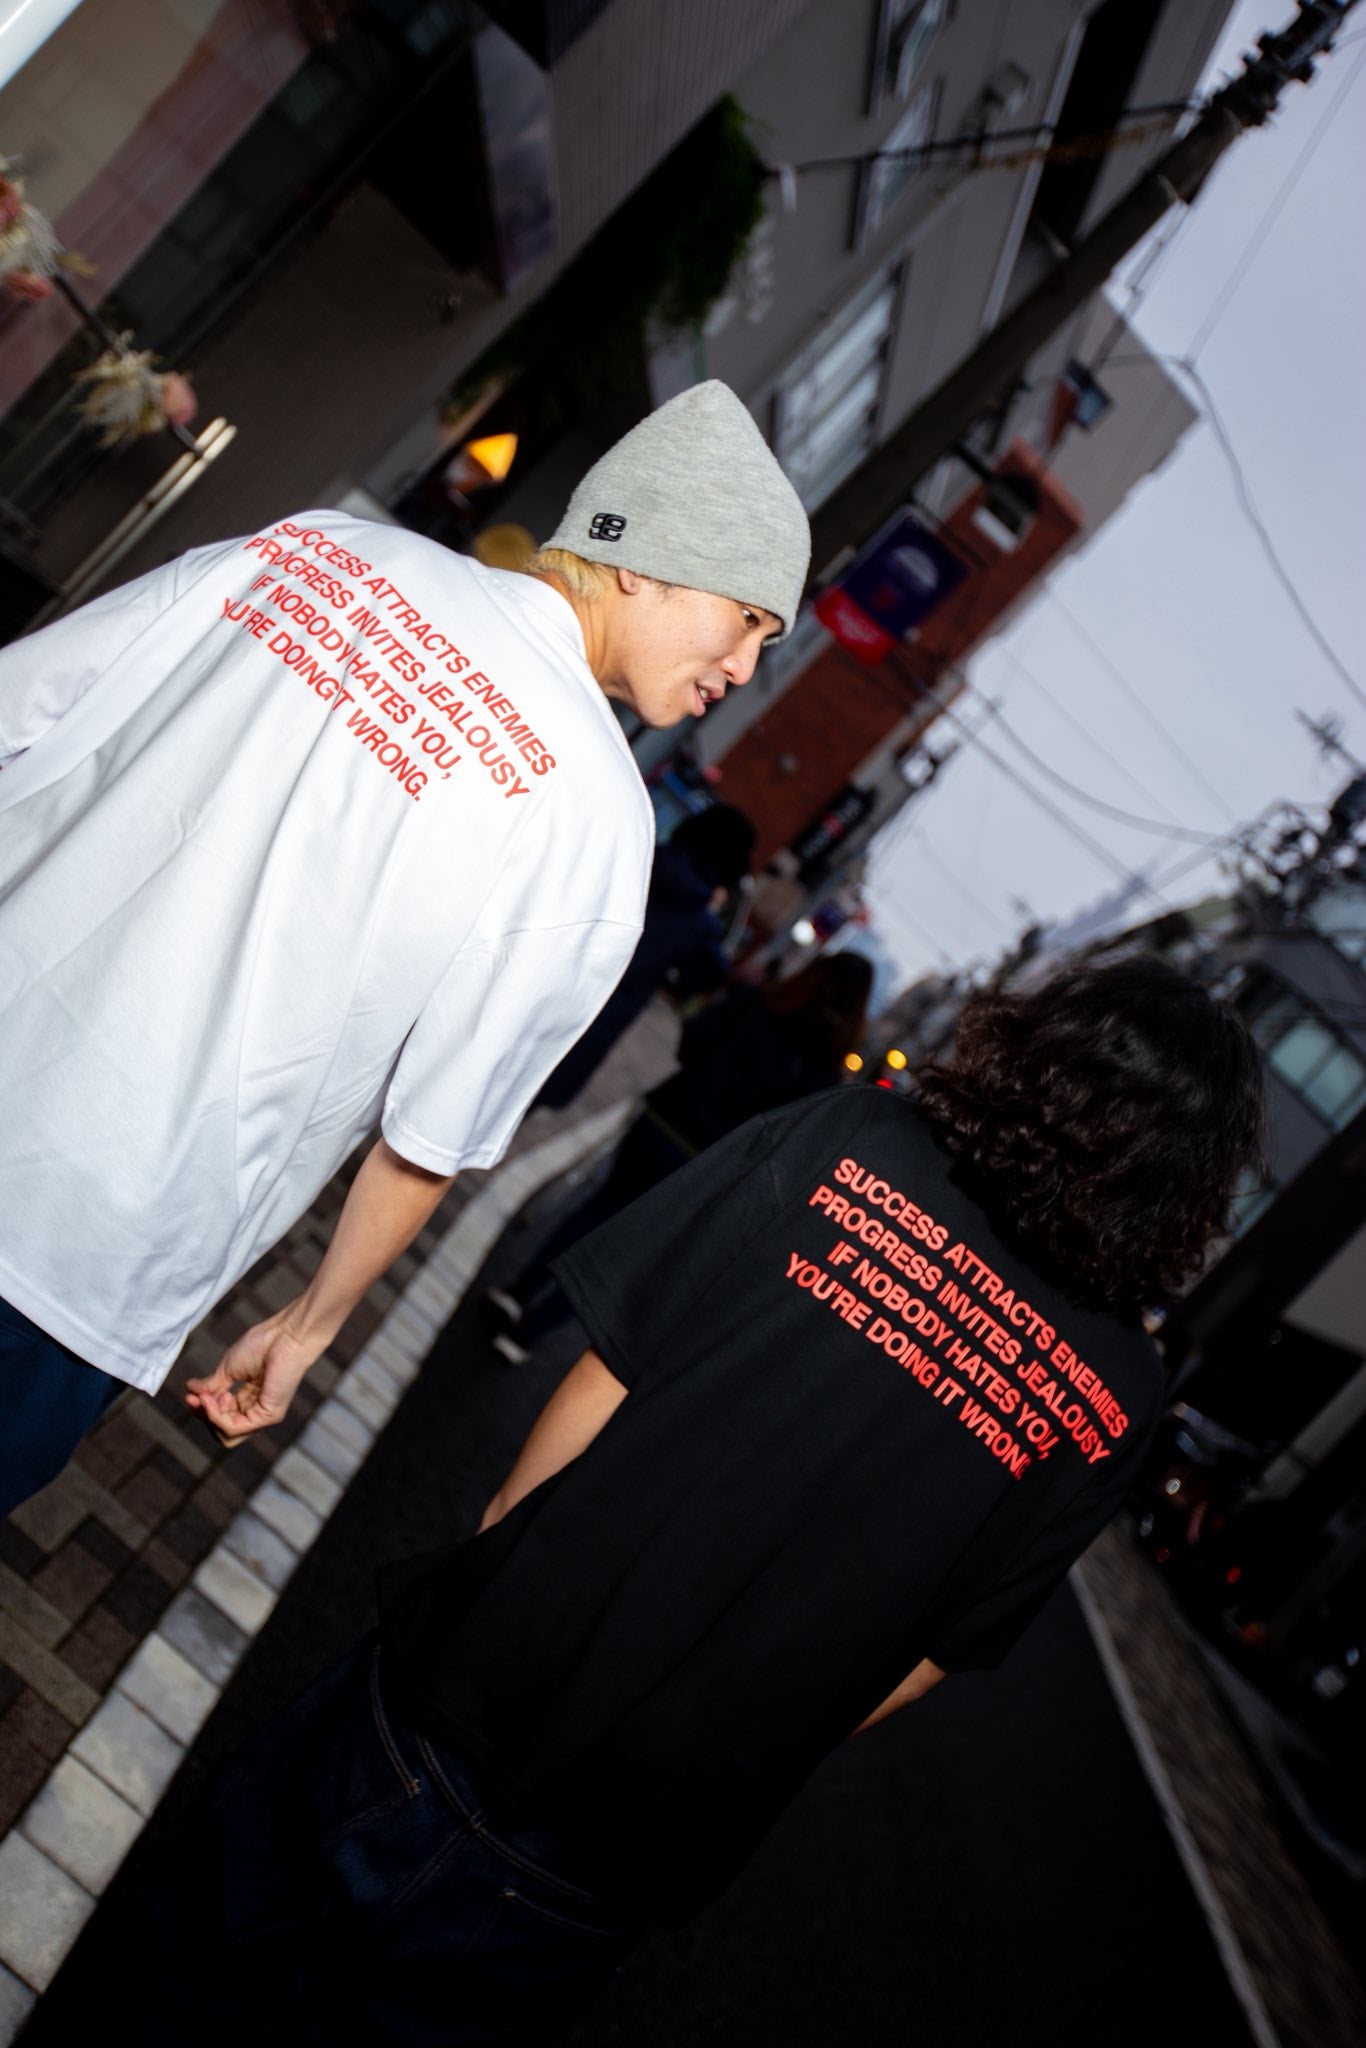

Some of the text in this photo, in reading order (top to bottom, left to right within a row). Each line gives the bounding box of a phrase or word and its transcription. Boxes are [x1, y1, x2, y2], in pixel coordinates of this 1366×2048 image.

[220, 597, 277, 640] YU'RE
[266, 630, 340, 702] DOING
[346, 707, 429, 801] WRONG.
[243, 536, 531, 798] PROGRESS INVITES JEALOUSY
[250, 574, 462, 779] IF NOBODY HATES YOU,
[362, 576, 470, 674] ATTRACTS
[462, 671, 557, 776] ENEMIES
[785, 1251, 873, 1330] YOU'RE
[865, 1316, 941, 1389] DOING
[933, 1376, 966, 1406] IT
[808, 1184, 1111, 1464] PROGRESS INVITES JEALOUSY
[826, 1239, 1060, 1460] IF NOBODY HATES YOU,
[834, 1158, 1130, 1439] SUCCESS ATTRACTS ENEMIES
